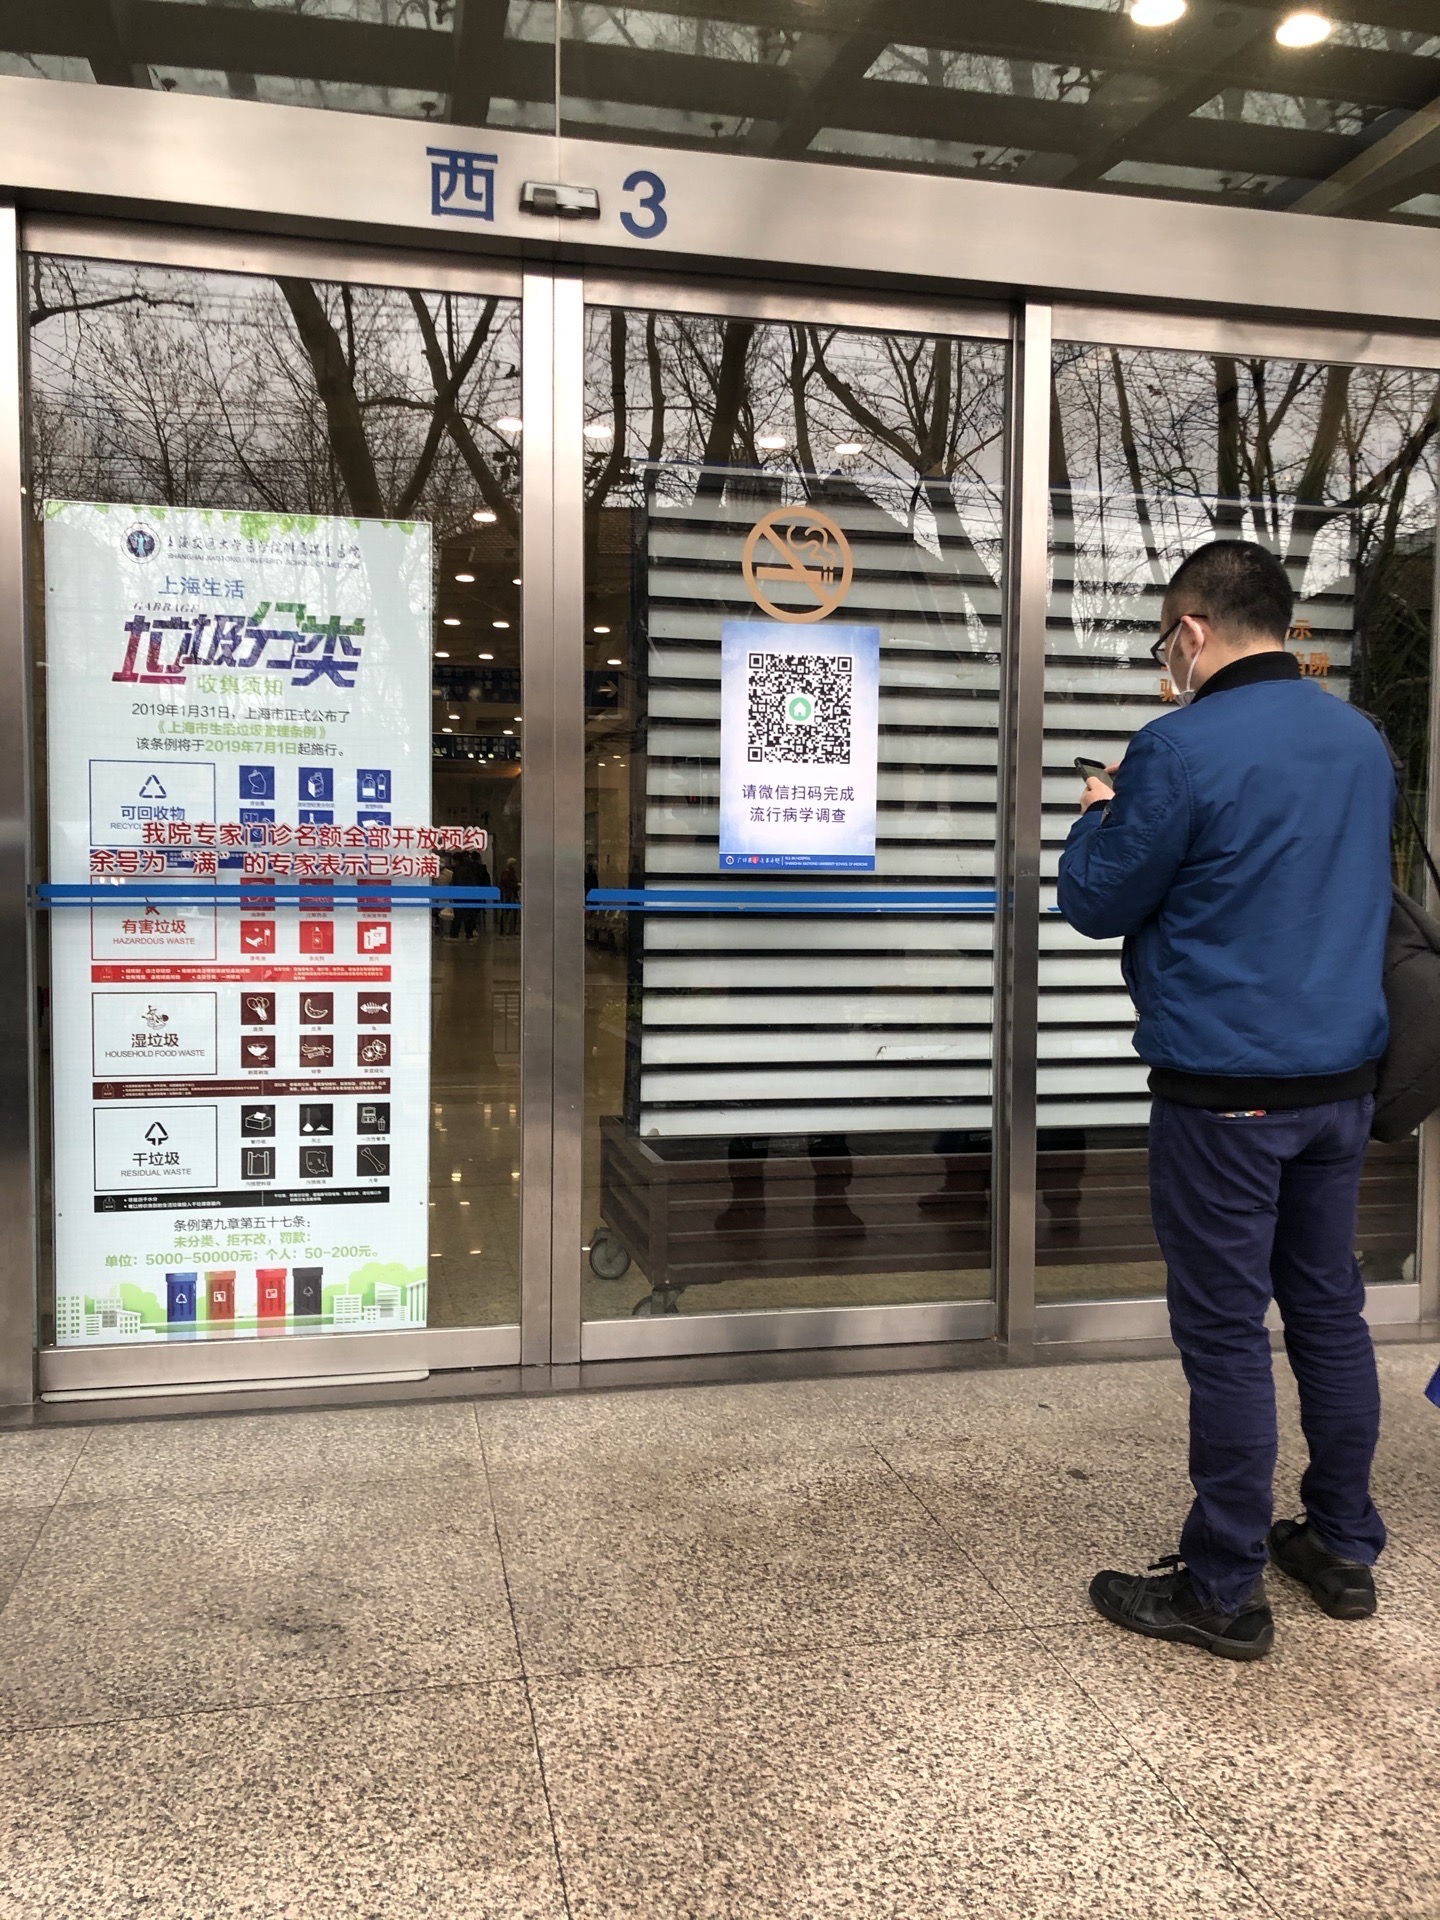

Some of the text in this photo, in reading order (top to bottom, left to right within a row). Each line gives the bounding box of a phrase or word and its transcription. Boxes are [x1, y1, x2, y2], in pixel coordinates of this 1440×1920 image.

[425, 146, 668, 240] 西 3
[158, 575, 245, 600] 上海生活
[111, 601, 365, 688] 垃圾分类
[198, 674, 283, 696] 收集须知
[741, 784, 855, 802] 请微信扫码完成
[120, 805, 185, 822] 可回收物
[750, 806, 846, 823] 流行病学调查
[110, 822, 143, 830] RECYCL
[142, 822, 487, 851] 我院专家门诊名额全部开放预约
[121, 919, 187, 935] 有害垃圾
[112, 937, 195, 945] HAZARDOUS WASTE
[131, 1033, 179, 1048] 湿垃圾
[105, 1049, 206, 1058] HOUSEHOLD FOOD WASTE
[132, 1151, 180, 1167] 干垃圾
[120, 1168, 192, 1178] RESIDUAL WASTE
